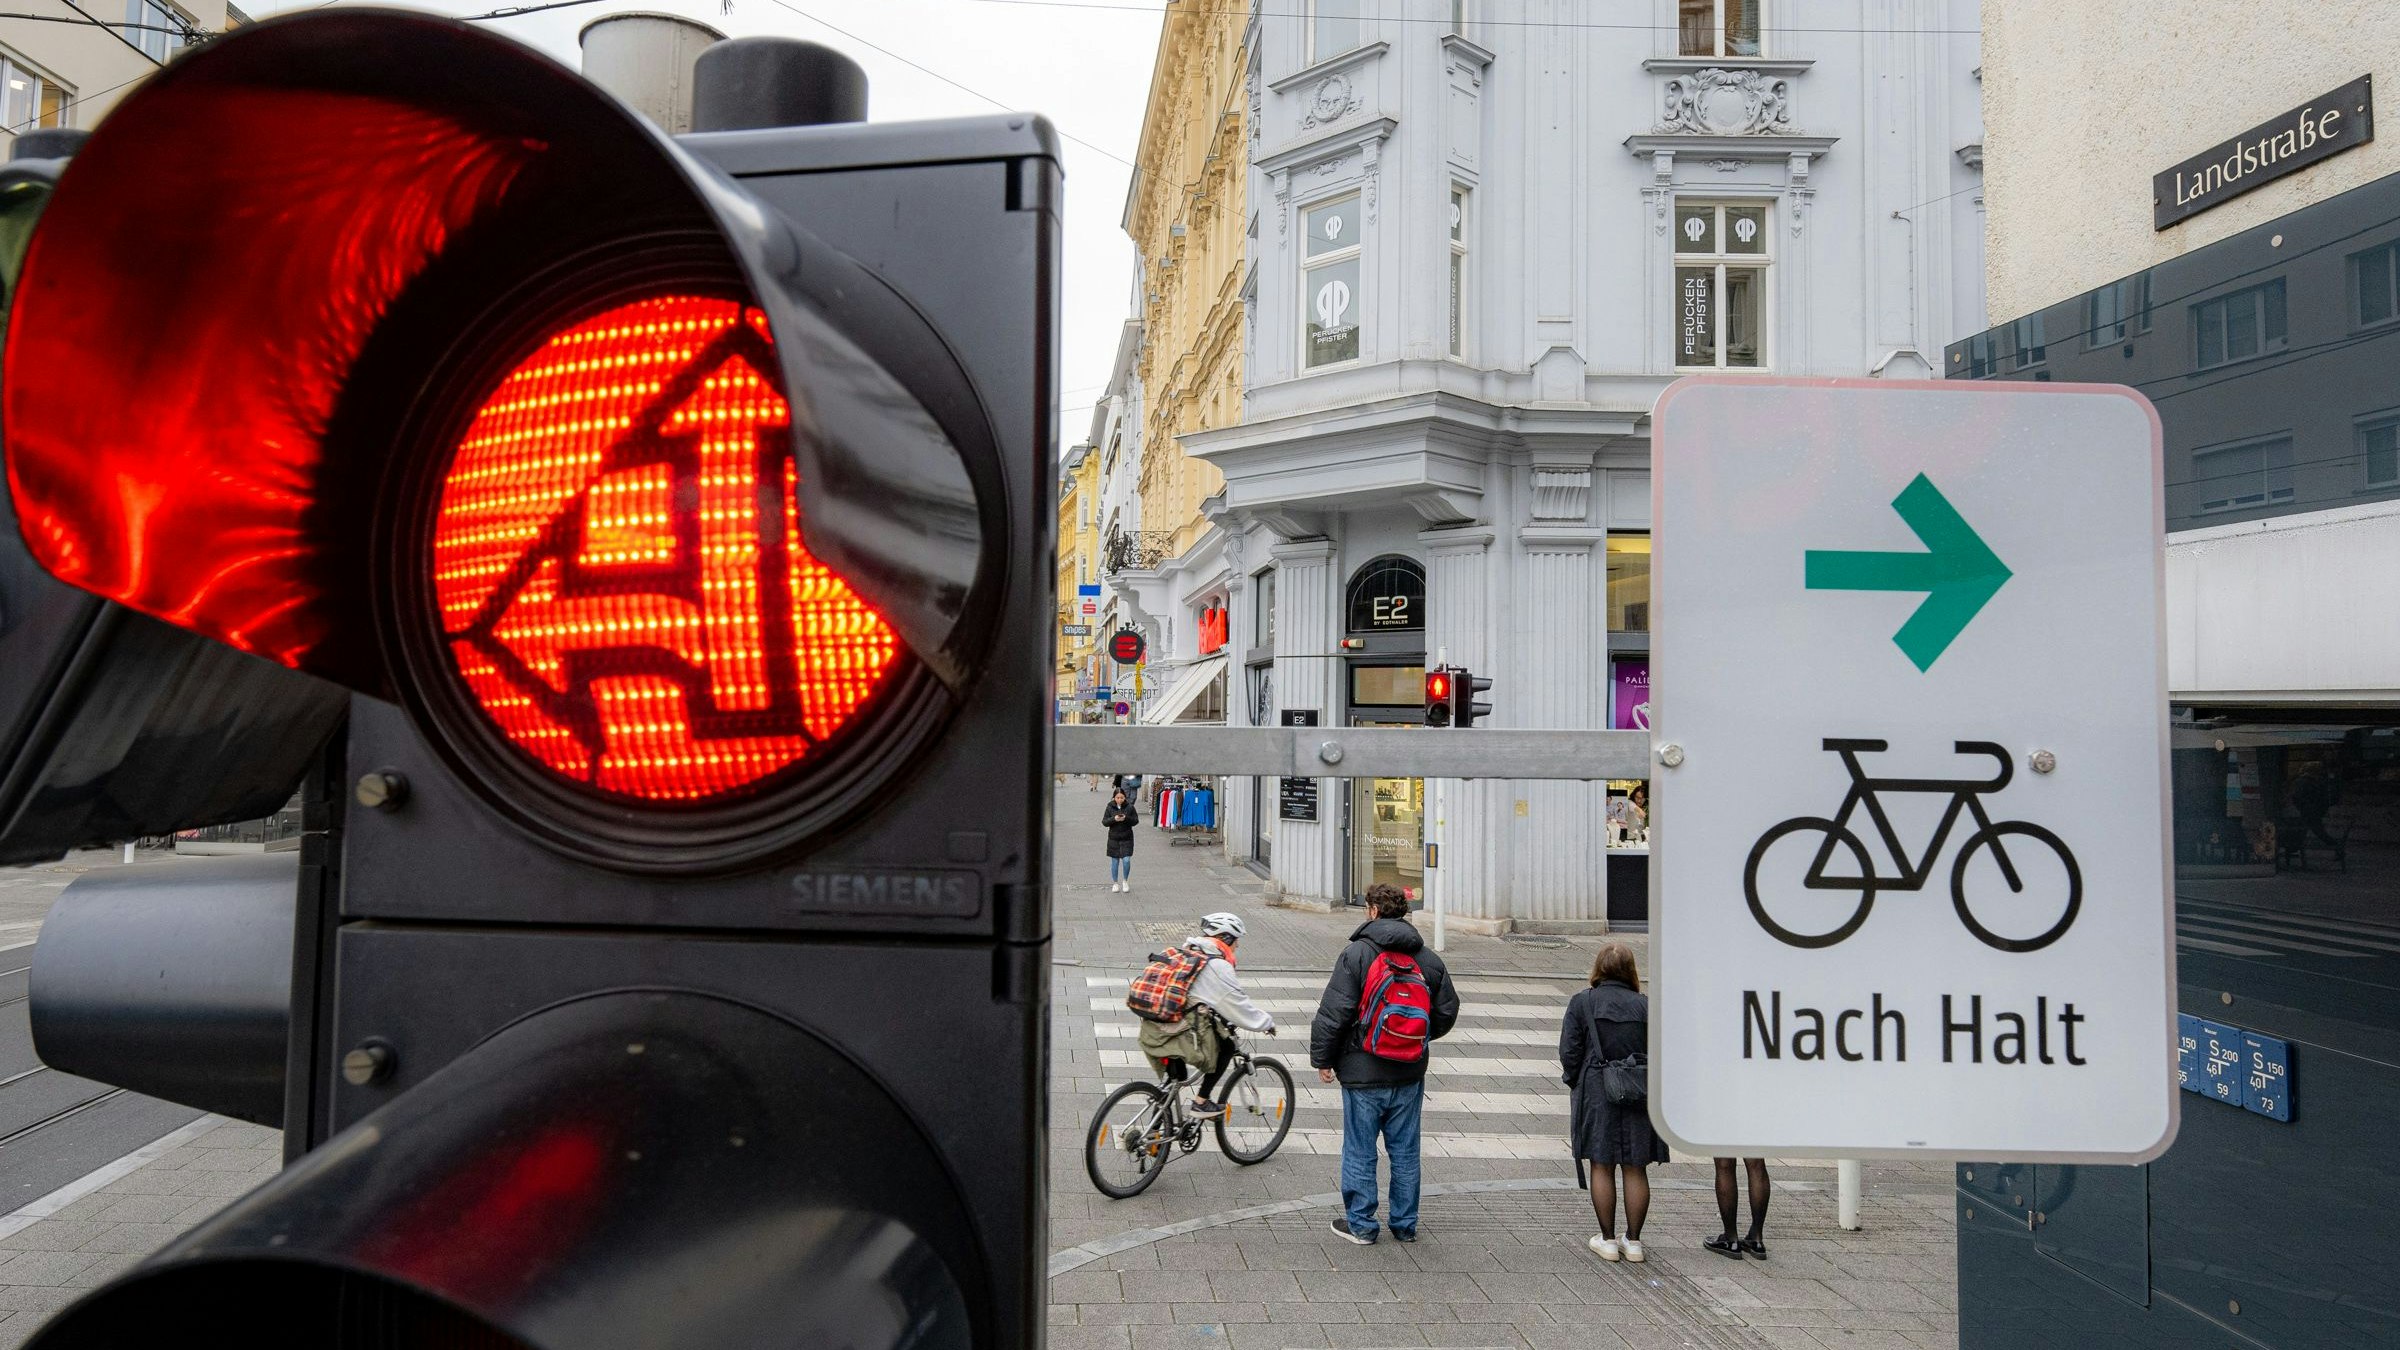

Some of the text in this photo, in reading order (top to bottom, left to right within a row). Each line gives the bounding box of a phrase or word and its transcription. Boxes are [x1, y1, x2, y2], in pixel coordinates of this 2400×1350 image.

[2176, 107, 2341, 206] Landstraße
[1696, 277, 1707, 334] PFISTER
[1684, 278, 1695, 355] PERÜCKEN
[1317, 333, 1347, 344] PFISTER
[1374, 595, 1408, 620] E2
[1064, 626, 1087, 635] snipes
[1294, 716, 1305, 724] E2
[1364, 833, 1413, 849] NOMINATION
[793, 873, 964, 906] SIEMENS
[1743, 990, 2087, 1066] Nach Halt
[2182, 1037, 2196, 1050] 150
[2209, 1040, 2239, 1063] S 200
[2206, 1063, 2218, 1075] 46
[2253, 1052, 2284, 1076] S 150
[2217, 1083, 2229, 1096] 59
[2249, 1076, 2261, 1089] 40
[2261, 1097, 2274, 1110] 73
